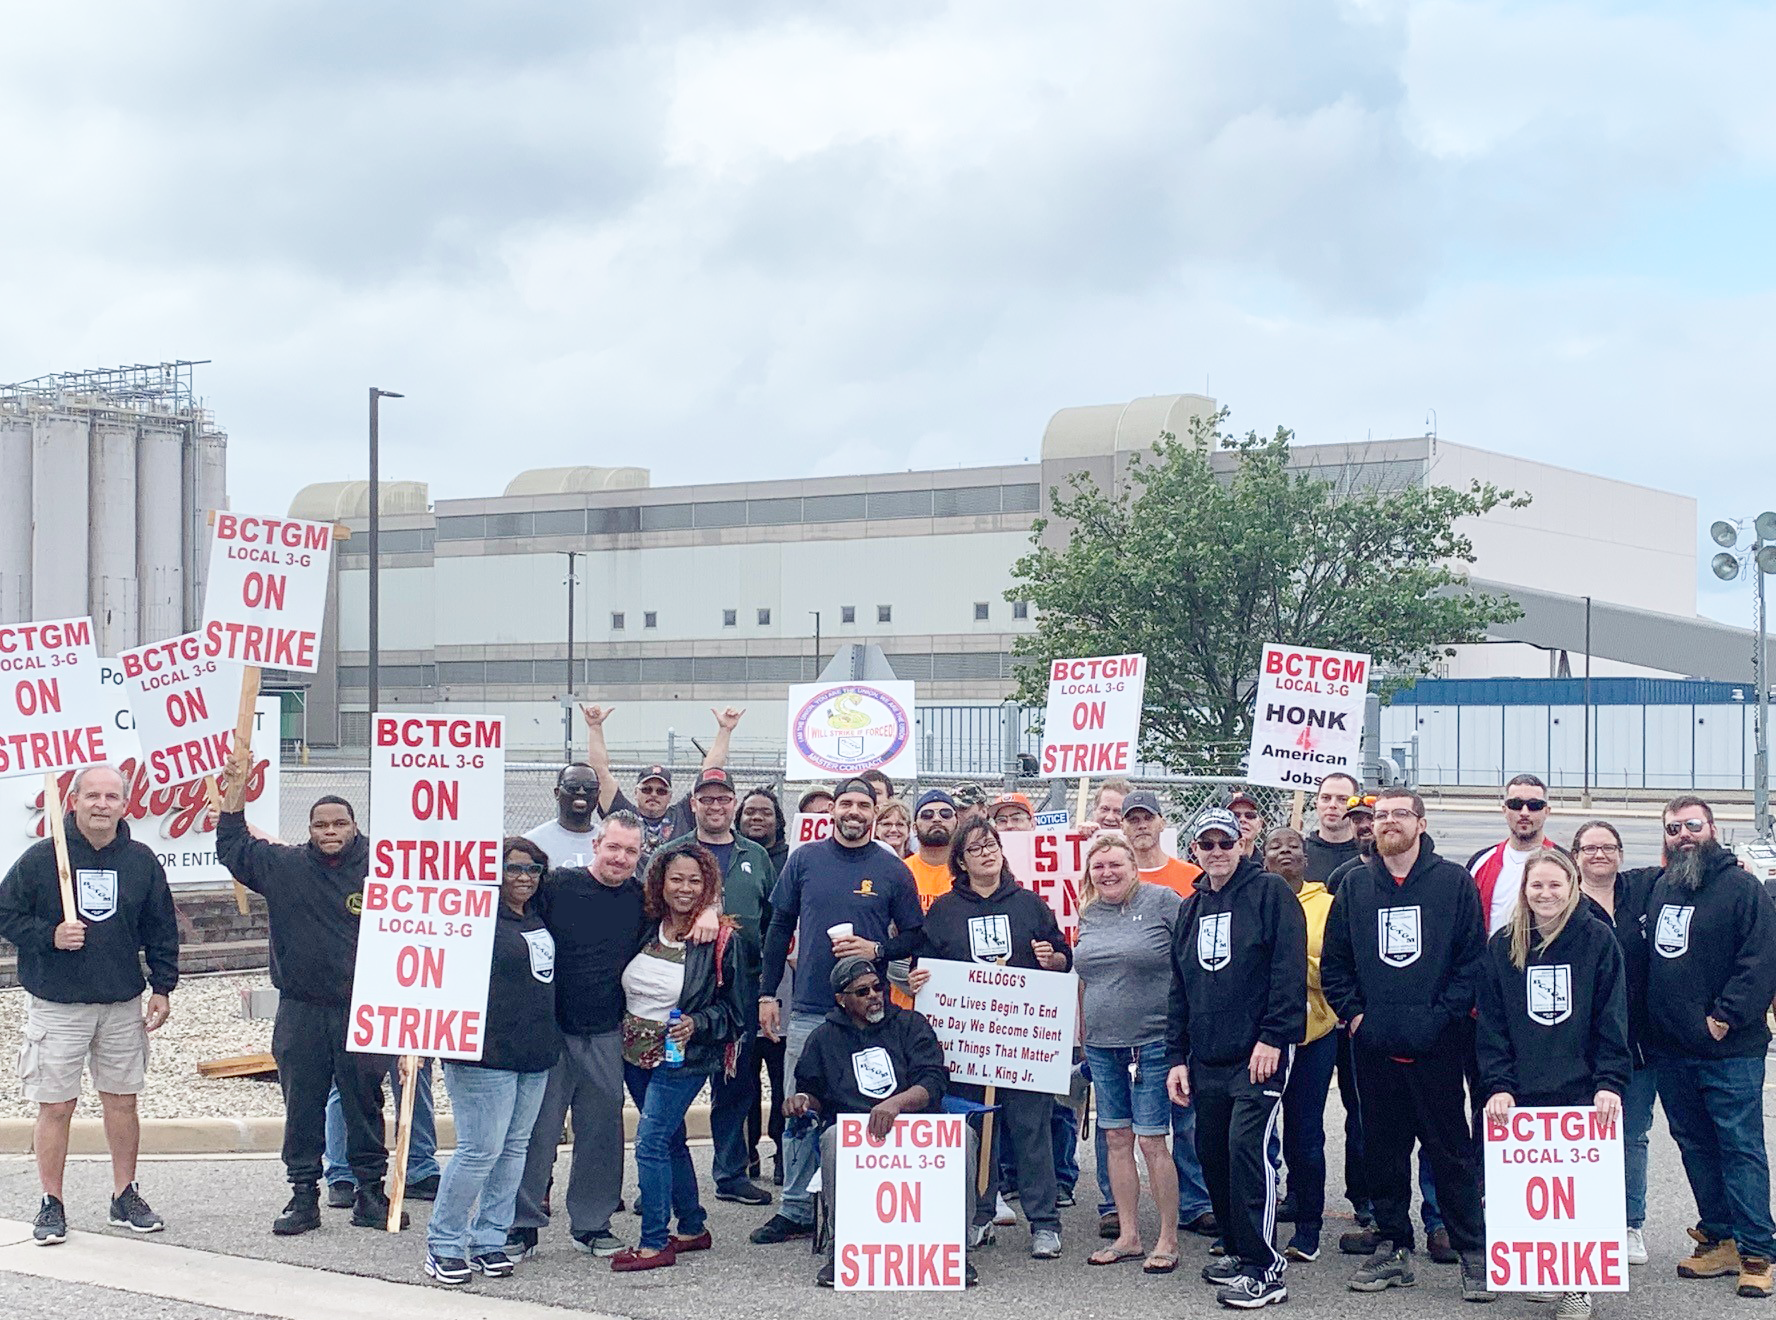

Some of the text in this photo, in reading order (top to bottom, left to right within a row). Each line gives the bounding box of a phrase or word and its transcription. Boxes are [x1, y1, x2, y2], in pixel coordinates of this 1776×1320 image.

[218, 516, 328, 551] BCTGM
[228, 547, 310, 567] LOCAL 3-G
[243, 572, 285, 610] ON
[0, 622, 89, 652] CTGM
[205, 622, 315, 666] STRIKE
[0, 652, 77, 671] OCAL 3-G
[123, 637, 199, 678] BCTG
[1054, 658, 1137, 680] BCTGM
[1266, 651, 1364, 684] BCTGM
[141, 661, 216, 692] LOCAL 3-G
[1062, 682, 1124, 694] LOCAL 3-G
[1276, 676, 1349, 696] LOCAL 3-G
[16, 678, 60, 716] ON
[166, 688, 207, 726] ON
[1073, 702, 1105, 730] ON
[1266, 703, 1347, 732] HONK
[378, 719, 500, 748] BCTGM
[811, 727, 828, 739] WILL
[830, 729, 855, 738] STRIKE
[1296, 727, 1313, 750] 4
[150, 731, 236, 784] STRIK
[391, 753, 484, 768] LOCAL 3-G
[808, 753, 883, 771] MASTER CONTRACT
[1044, 742, 1128, 772] STRIKE
[1262, 742, 1346, 765] American
[1281, 770, 1322, 786] Jobs
[412, 780, 458, 820] ON
[1035, 813, 1066, 825] NOTICE
[157, 854, 176, 868] OR
[375, 840, 497, 880] STRIKE
[367, 883, 491, 916] BCTGM
[379, 918, 472, 937] LOCAL 3-G
[397, 946, 444, 988] ON
[968, 970, 1027, 988] KELLOGG'S
[961, 996, 986, 1010] Lives
[991, 998, 1019, 1017] Begin
[1023, 1003, 1035, 1016] To
[1039, 1004, 1058, 1019] End
[354, 1005, 479, 1052] STRIKE
[948, 1016, 967, 1034] Day
[970, 1018, 985, 1033] We
[989, 1021, 1029, 1038] Become
[1032, 1026, 1062, 1042] Silent
[958, 1039, 991, 1058] Things
[995, 1043, 1018, 1059] That
[949, 1060, 1035, 1084] Dr. M. L. King Jr.
[1487, 1111, 1615, 1142] BCTGM
[856, 1155, 945, 1169] LOCAL 3-G
[1503, 1148, 1599, 1163] LOCAL 3-G
[876, 1182, 920, 1222] ON
[1526, 1176, 1574, 1220] ON
[841, 1244, 960, 1286] STRIKE
[1491, 1242, 1620, 1285] STRIKE
